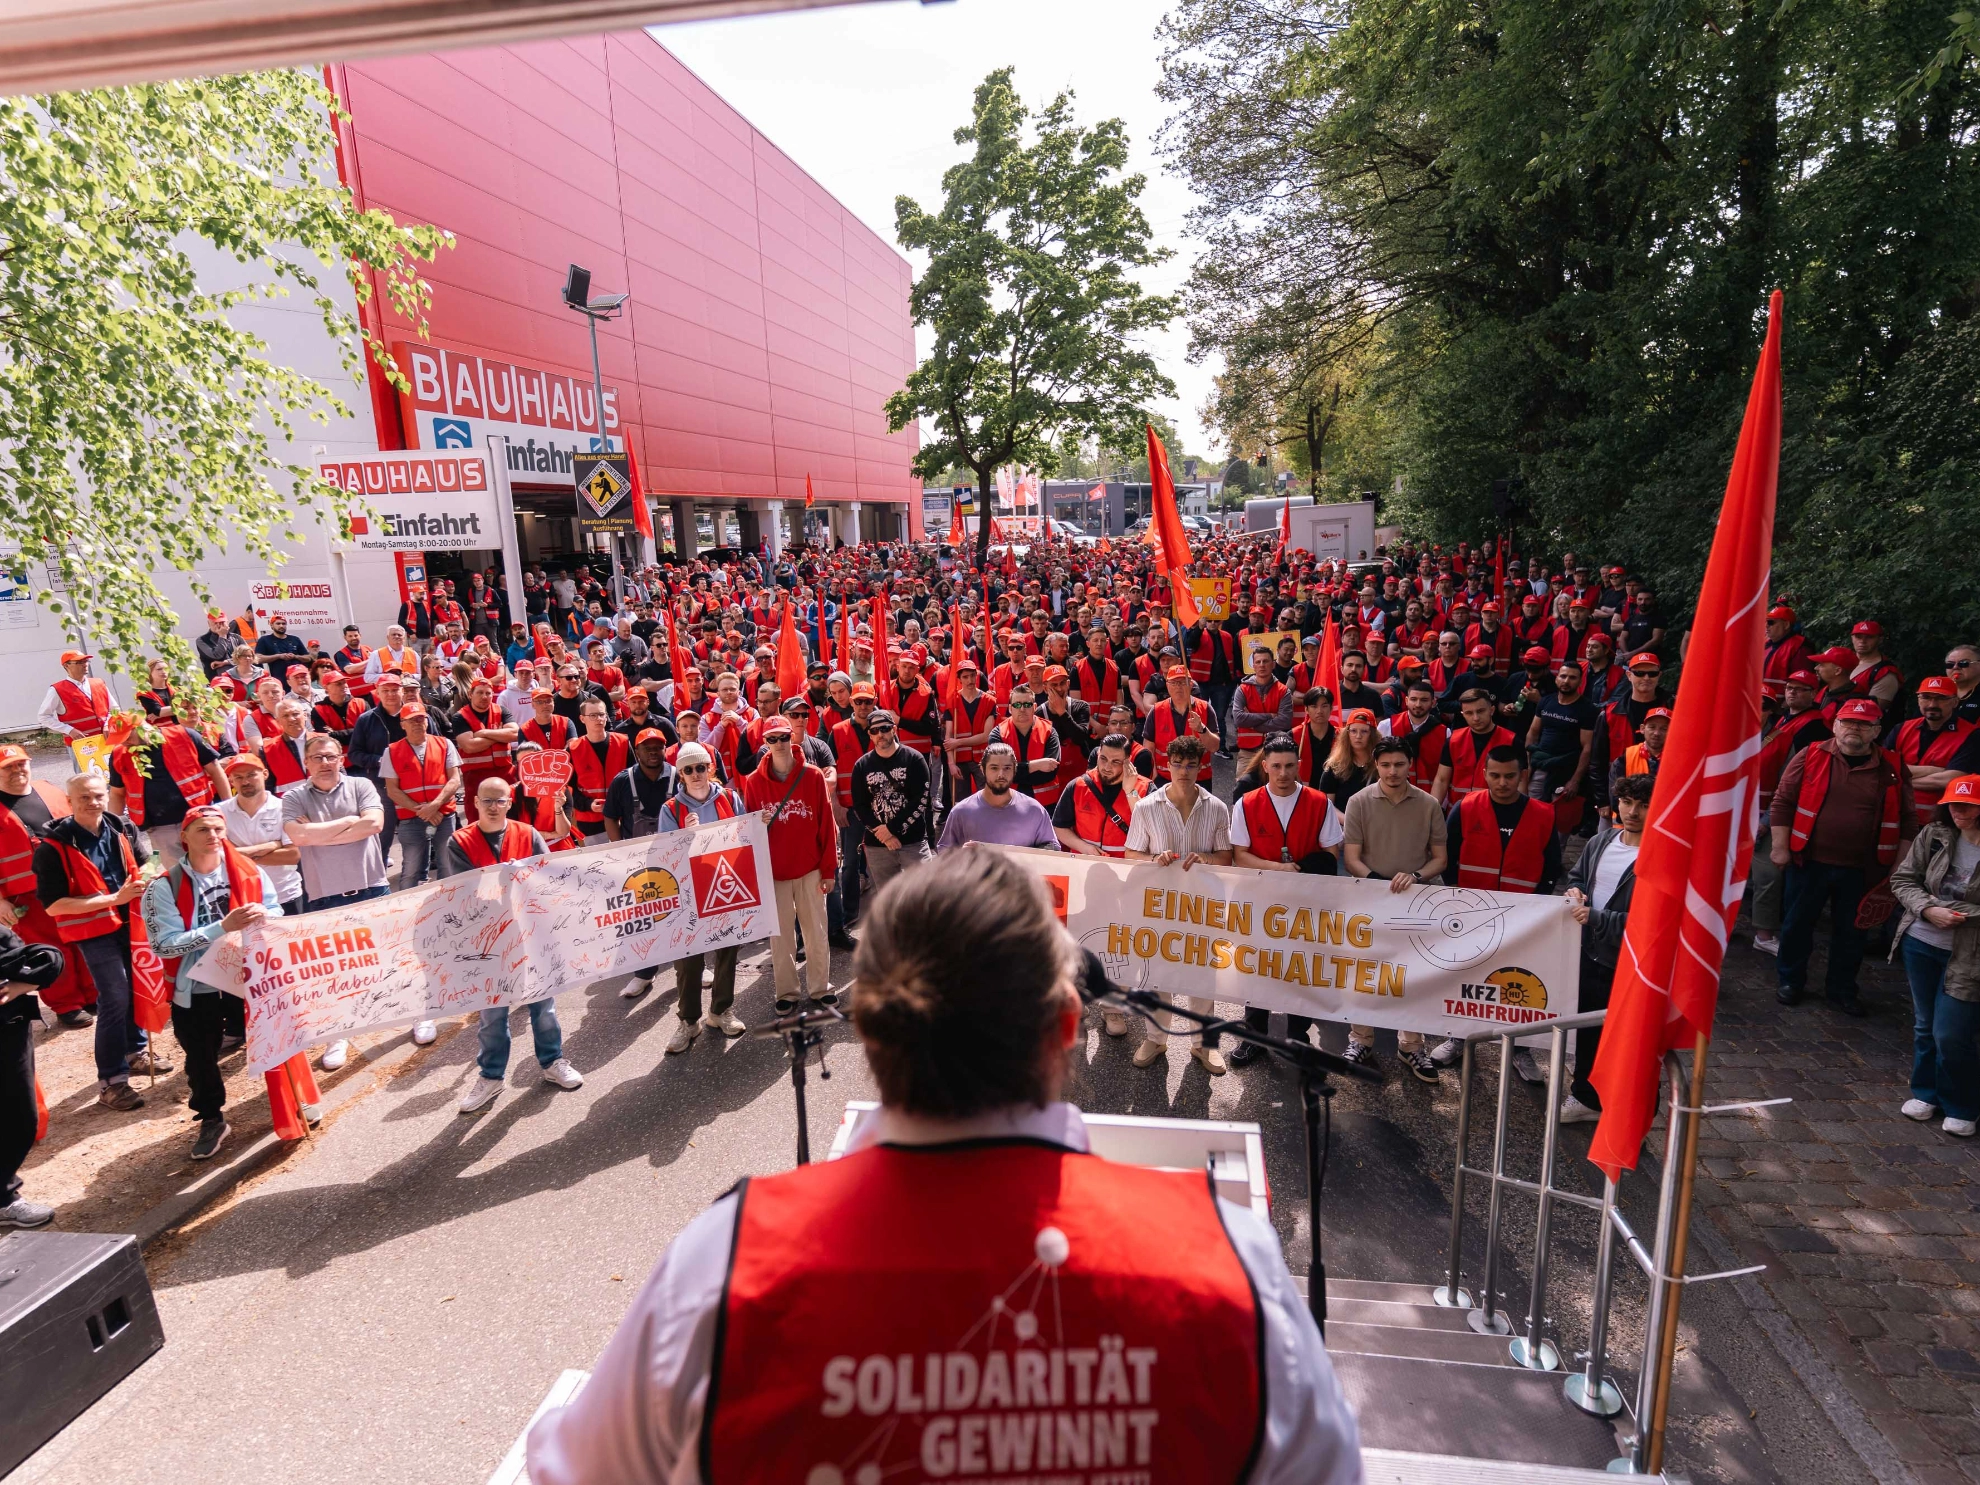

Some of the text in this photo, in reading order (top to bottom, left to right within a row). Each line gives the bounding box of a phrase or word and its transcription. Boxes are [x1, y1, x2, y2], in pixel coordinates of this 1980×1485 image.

[411, 352, 619, 429] BAUHAUS
[324, 462, 482, 491] BAUHAUS
[381, 512, 481, 537] Einfahrt
[361, 539, 477, 550] Montag-Samstag 8:00-20:00 Uhr
[272, 608, 328, 616] Warenannahme
[606, 892, 634, 911] KFZ
[644, 890, 656, 899] HU
[594, 896, 681, 928] TARIFRUNDE
[614, 916, 653, 938] 2025
[1143, 886, 1373, 949] EINEN GANG
[255, 947, 283, 974] %
[288, 927, 376, 966] MEHR
[1107, 922, 1407, 999] HOCHSCHALTEN
[249, 952, 380, 999] NÖTIG UND FAIR!
[263, 997, 289, 1019] Ich
[292, 990, 323, 1006] bin
[327, 969, 384, 995] dabei!
[1461, 983, 1497, 1002] KFZ
[1509, 991, 1520, 999] HU
[821, 1334, 1158, 1418] SOLIDARITÄT
[920, 1411, 1159, 1477] GEWINNT
